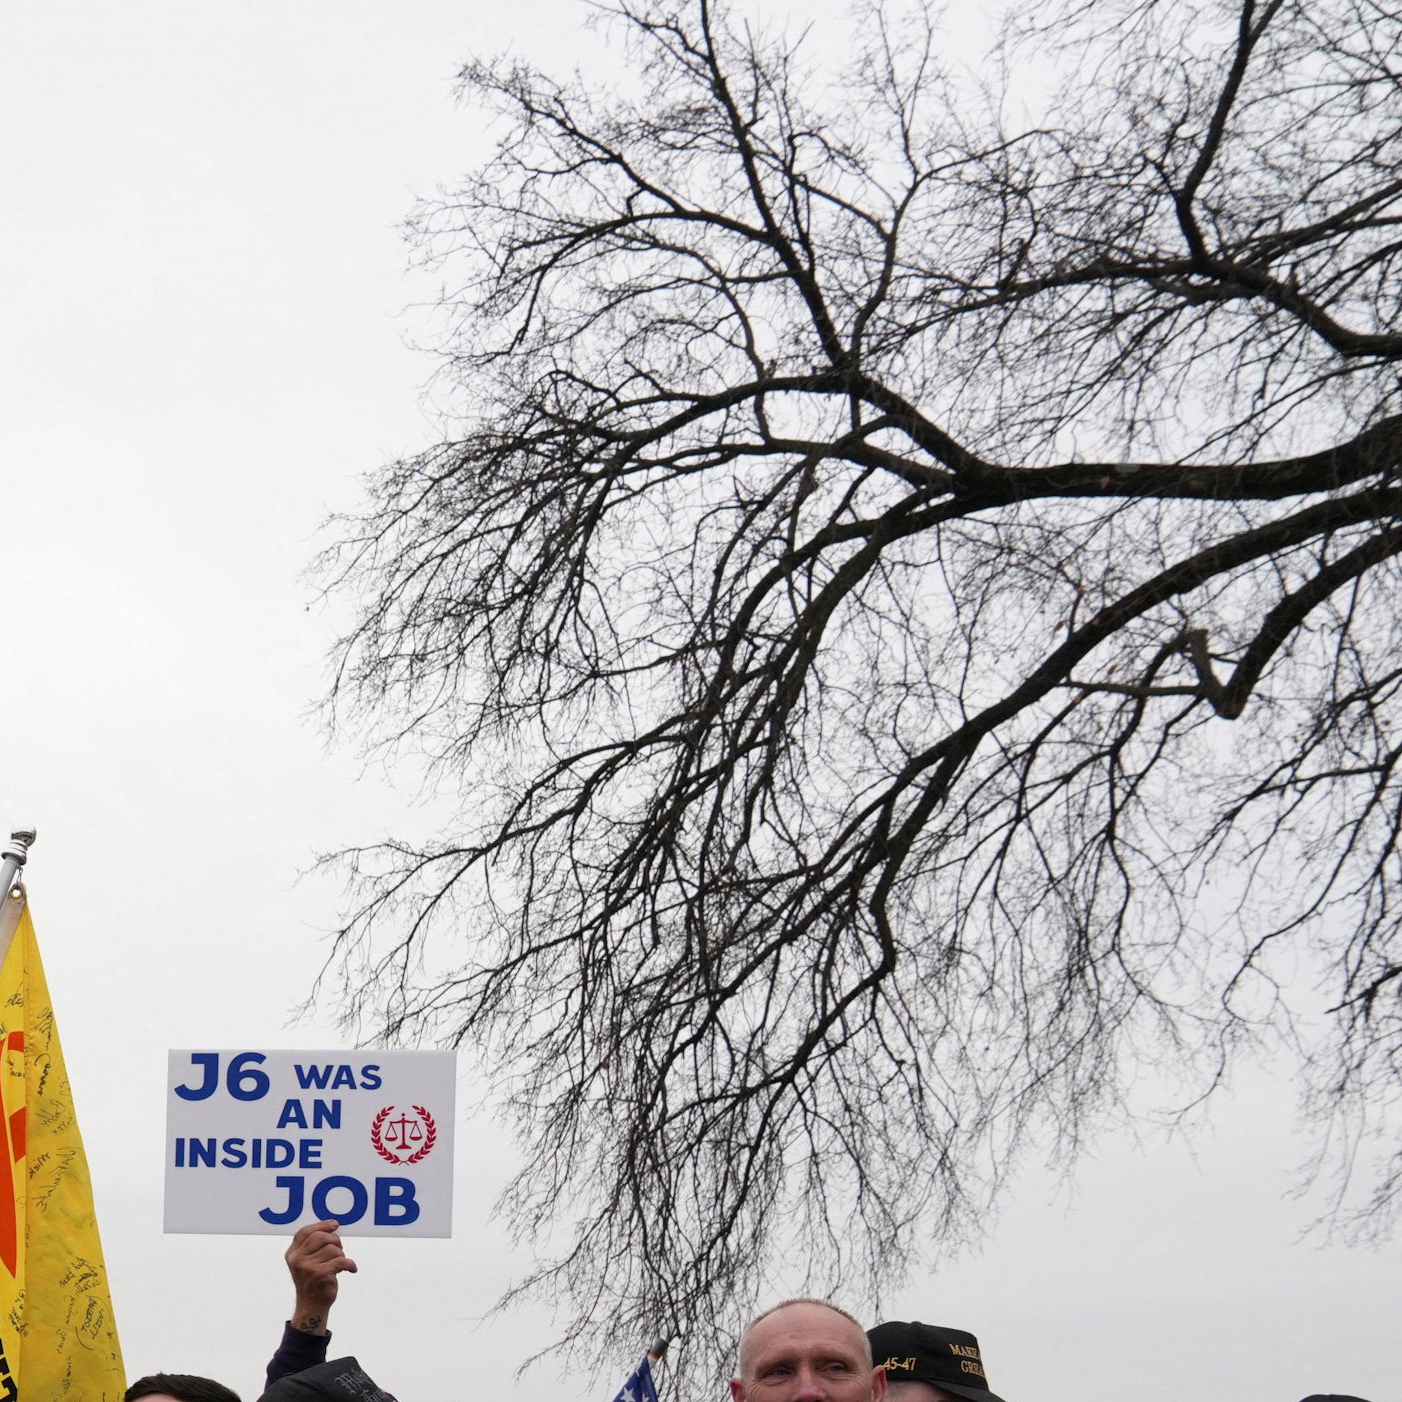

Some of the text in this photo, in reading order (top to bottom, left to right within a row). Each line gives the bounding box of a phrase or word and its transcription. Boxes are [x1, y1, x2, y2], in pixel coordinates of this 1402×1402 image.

[174, 1051, 383, 1102] J6 WAS
[276, 1098, 342, 1130] AN
[174, 1137, 323, 1169] INSIDE
[258, 1175, 420, 1226] JOB
[883, 1358, 917, 1372] 45-47
[949, 1344, 979, 1359] MAKE
